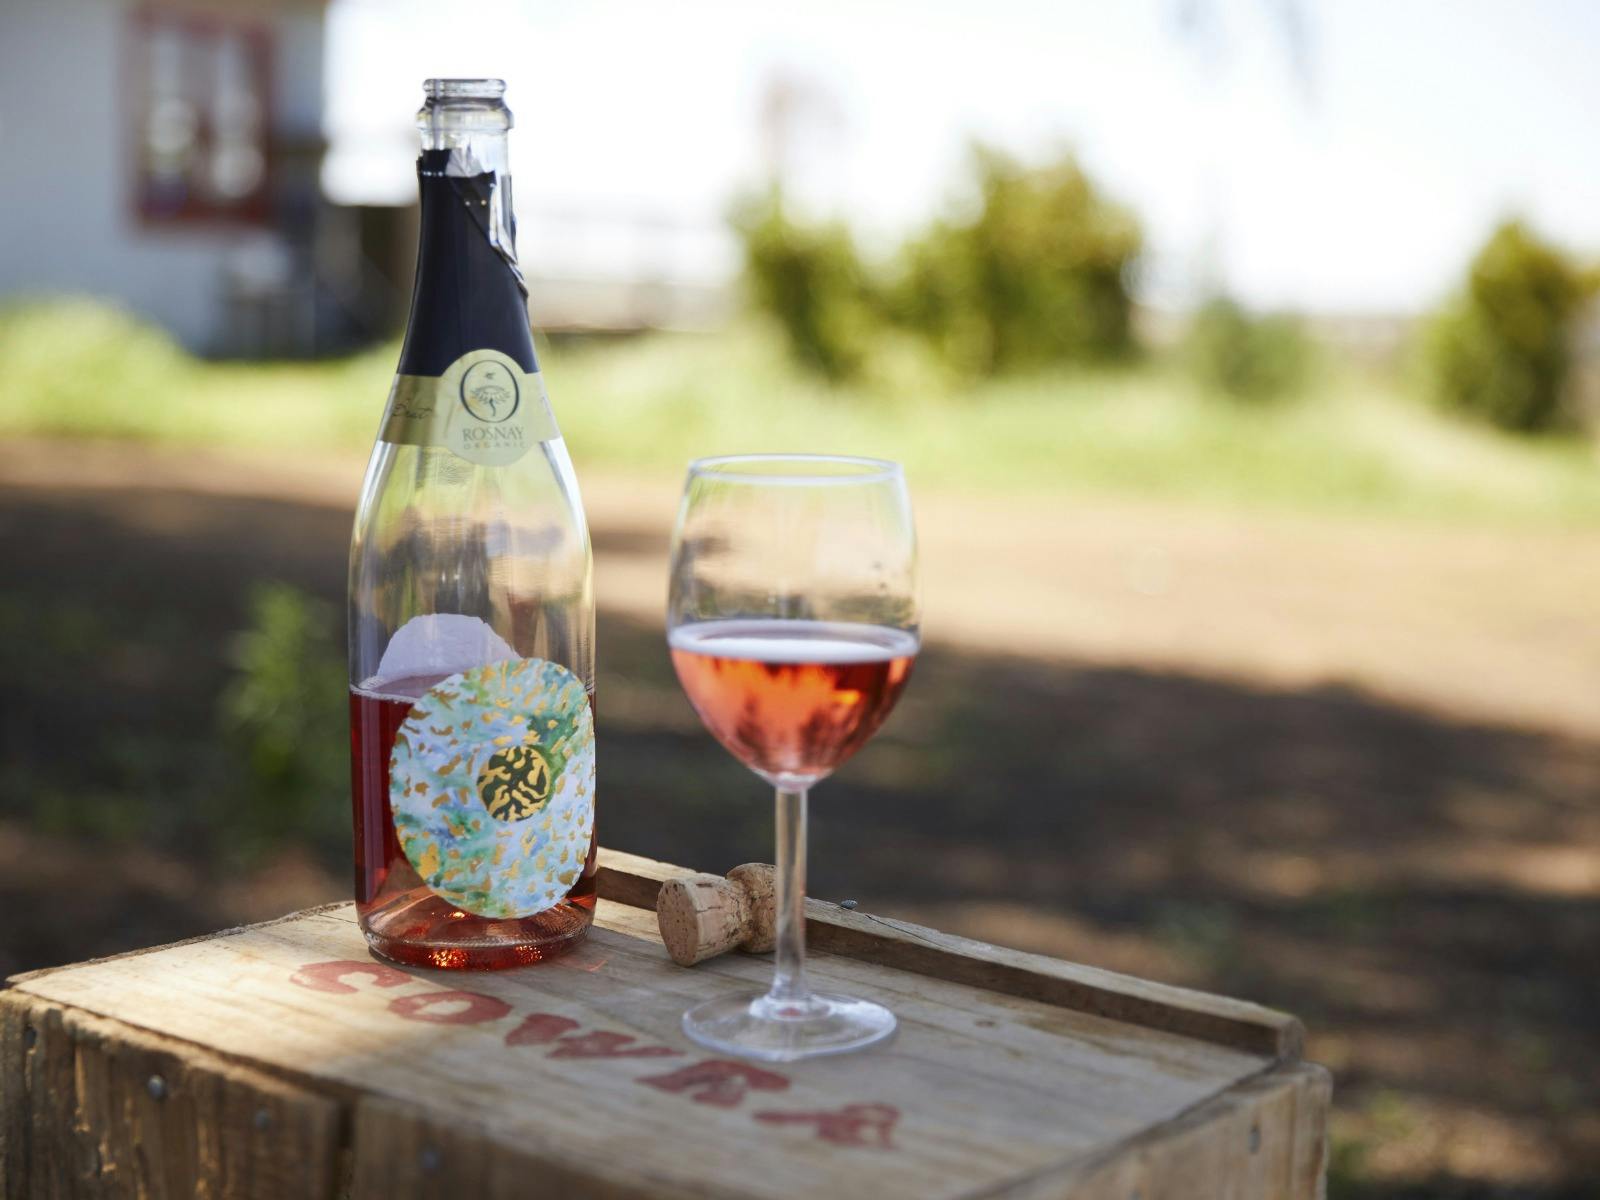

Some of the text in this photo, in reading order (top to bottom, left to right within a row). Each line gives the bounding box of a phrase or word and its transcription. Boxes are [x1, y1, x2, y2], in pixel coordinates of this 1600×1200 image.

[462, 426, 524, 442] ROSNAY
[463, 441, 526, 450] ORGANIC
[290, 959, 900, 1147] COWRA
